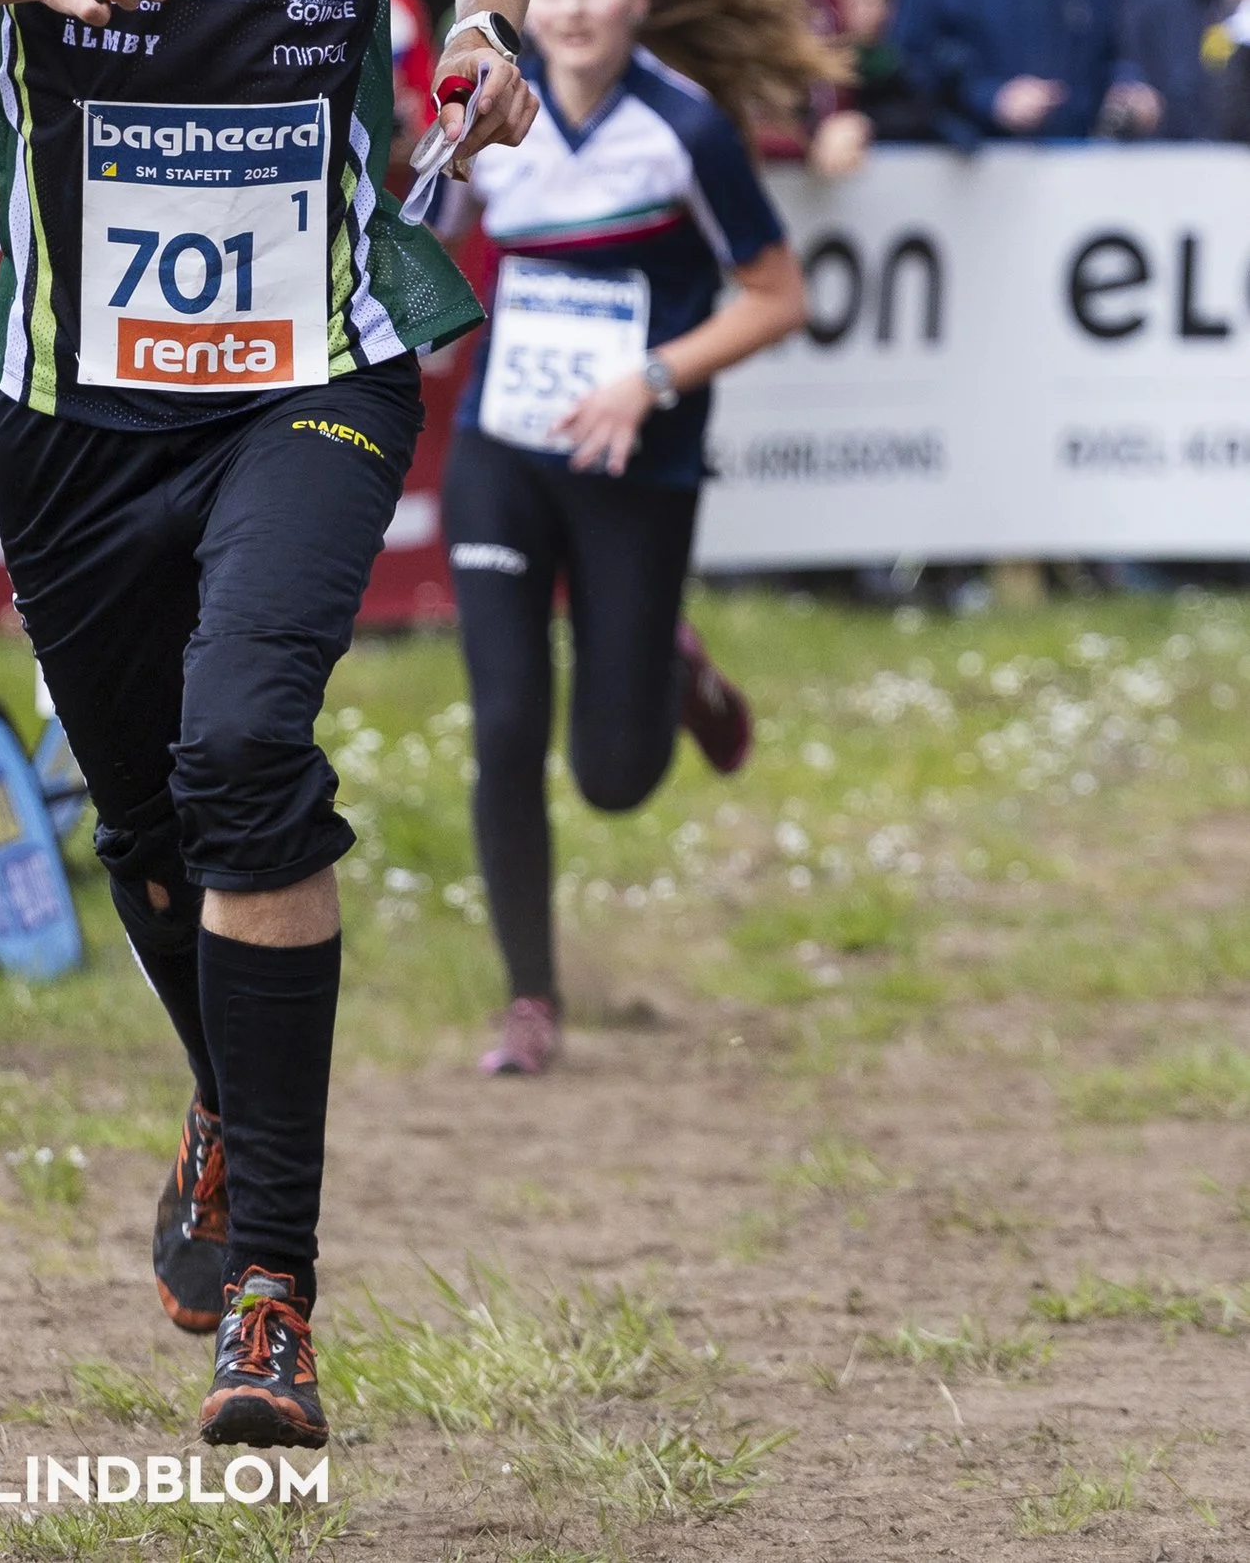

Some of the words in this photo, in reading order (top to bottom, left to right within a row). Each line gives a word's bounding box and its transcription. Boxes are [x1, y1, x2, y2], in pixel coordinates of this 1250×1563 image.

[62, 18, 160, 56] ÄLMBY
[92, 117, 319, 157] bagheera
[135, 165, 157, 178] SM
[165, 168, 232, 181] STAFETT
[244, 166, 279, 181] 2025
[291, 190, 308, 232] 1
[107, 226, 254, 315] 701
[1067, 234, 1250, 342] eL
[134, 333, 277, 373] renta
[503, 346, 597, 400] 555
